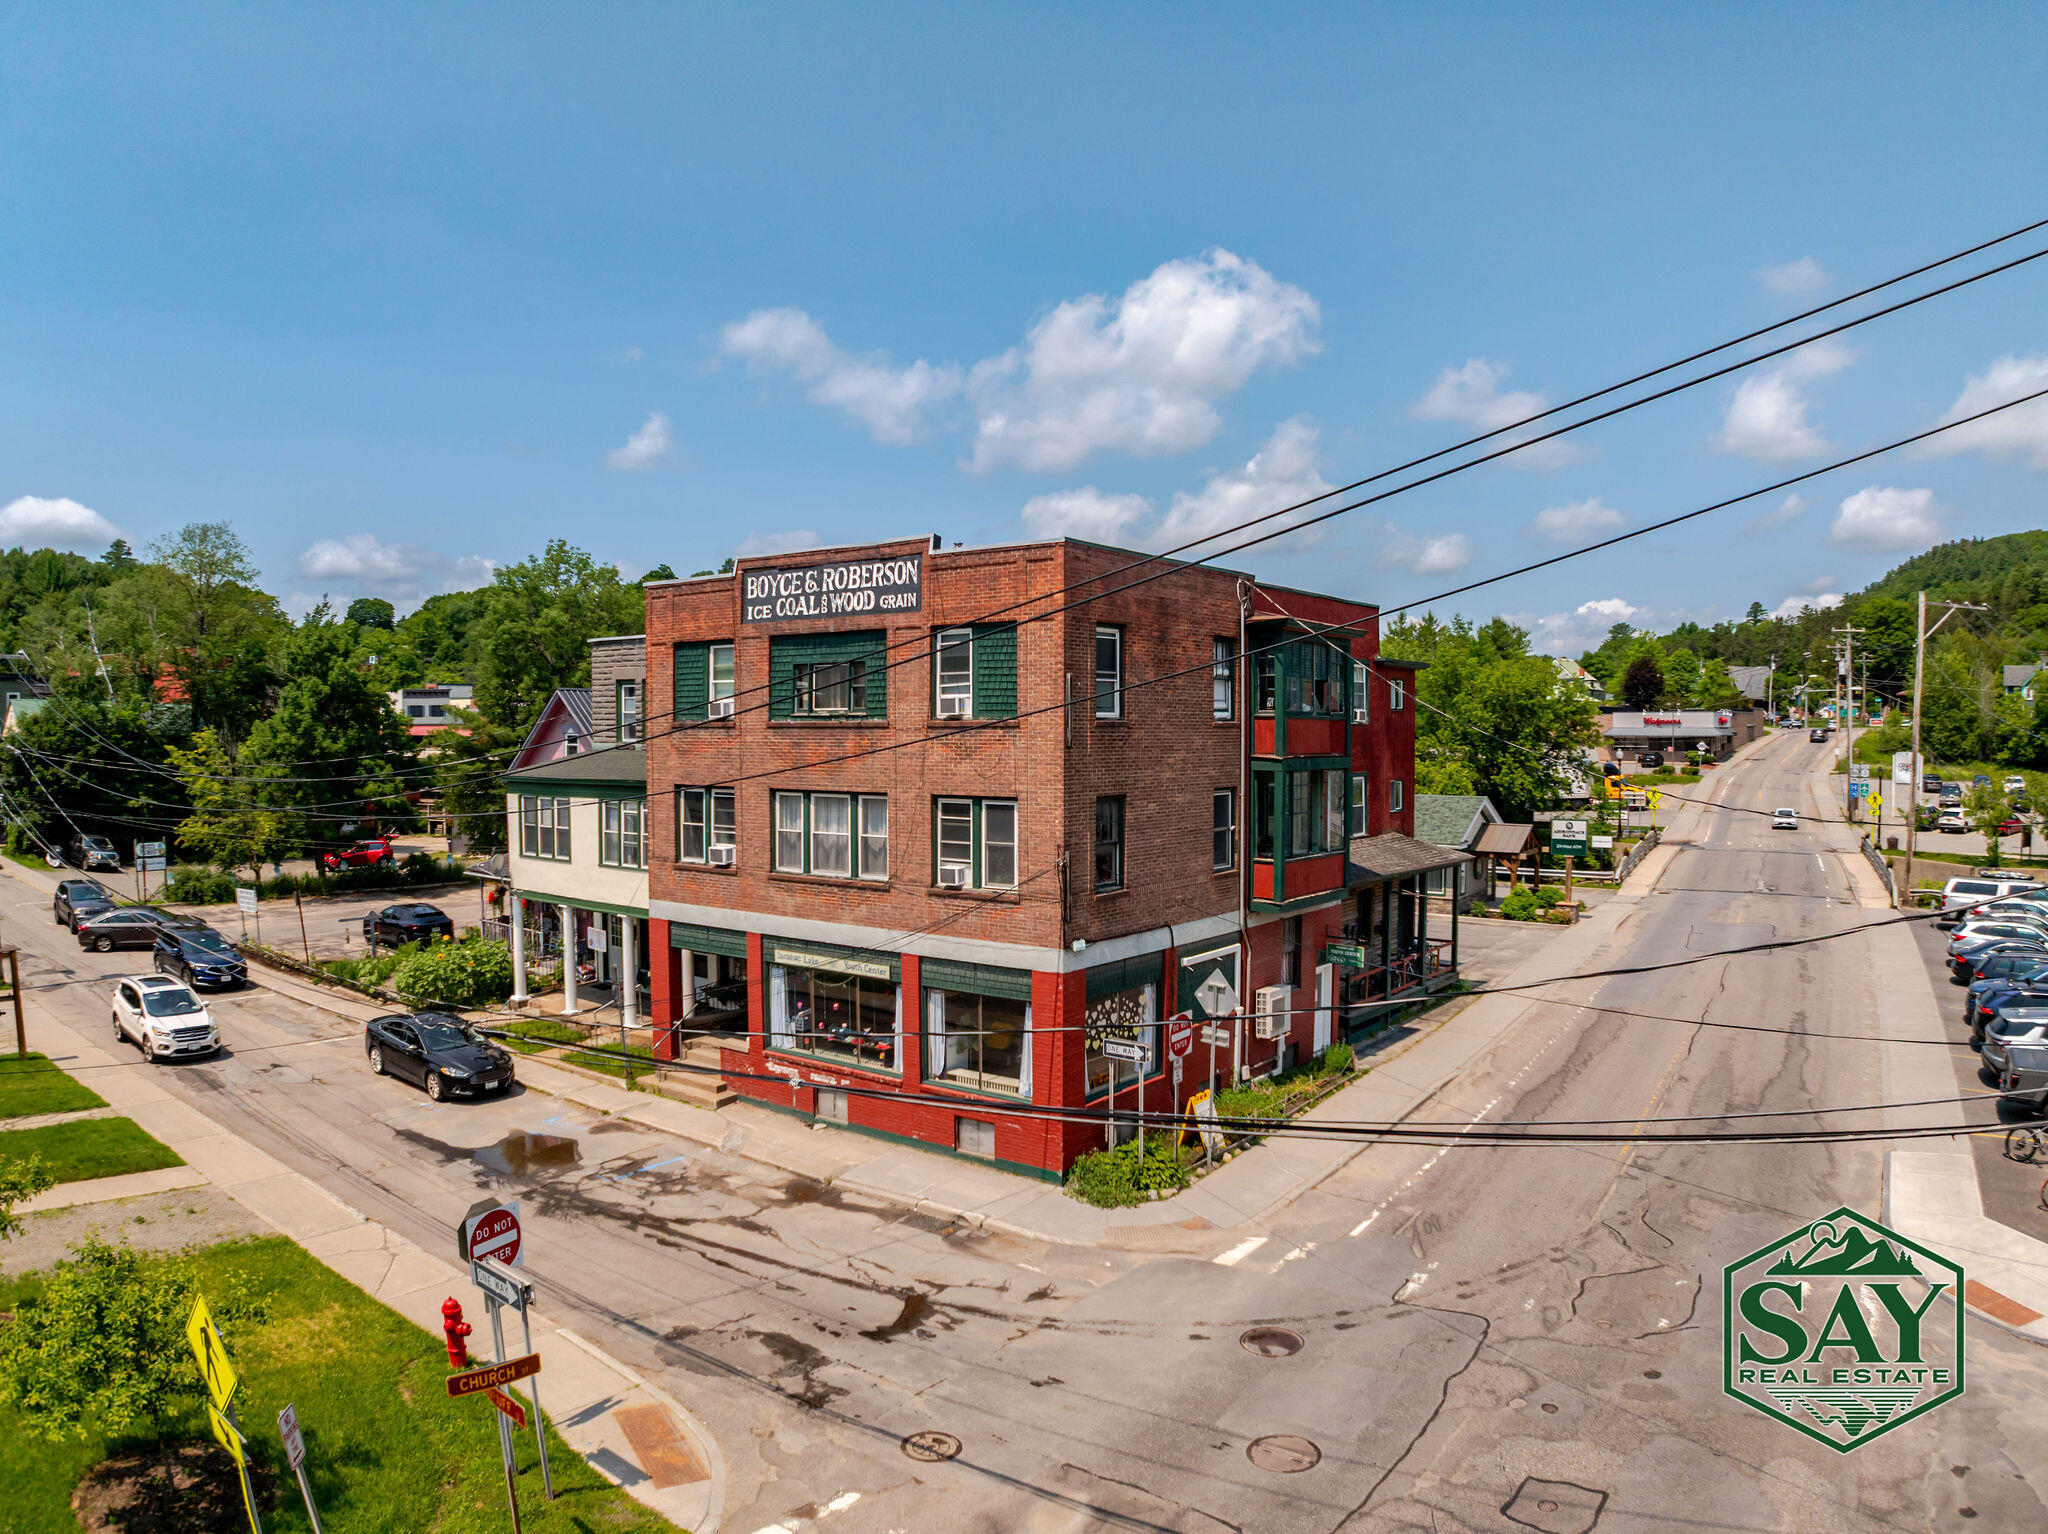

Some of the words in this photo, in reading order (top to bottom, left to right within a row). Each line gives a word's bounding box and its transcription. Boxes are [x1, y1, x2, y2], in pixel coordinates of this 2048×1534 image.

[747, 571, 804, 599] BOYCE
[804, 569, 820, 593] &
[821, 559, 919, 592] ROBERSON
[747, 604, 773, 620] ICE
[776, 595, 821, 617] COAL
[821, 594, 829, 614] AND
[829, 590, 876, 613] WOOD
[879, 592, 918, 610] GRAIN
[843, 959, 863, 971] Youth
[864, 963, 888, 976] Center
[1173, 1024, 1180, 1032] DO
[1107, 1043, 1120, 1054] ONE
[1122, 1047, 1135, 1056] WAY
[1174, 1039, 1188, 1051] ENTER
[475, 1227, 490, 1241] DO
[494, 1216, 512, 1233] NOT
[478, 1270, 492, 1285] ONE
[495, 1280, 509, 1294] WAY
[460, 1366, 516, 1391] CHURCH
